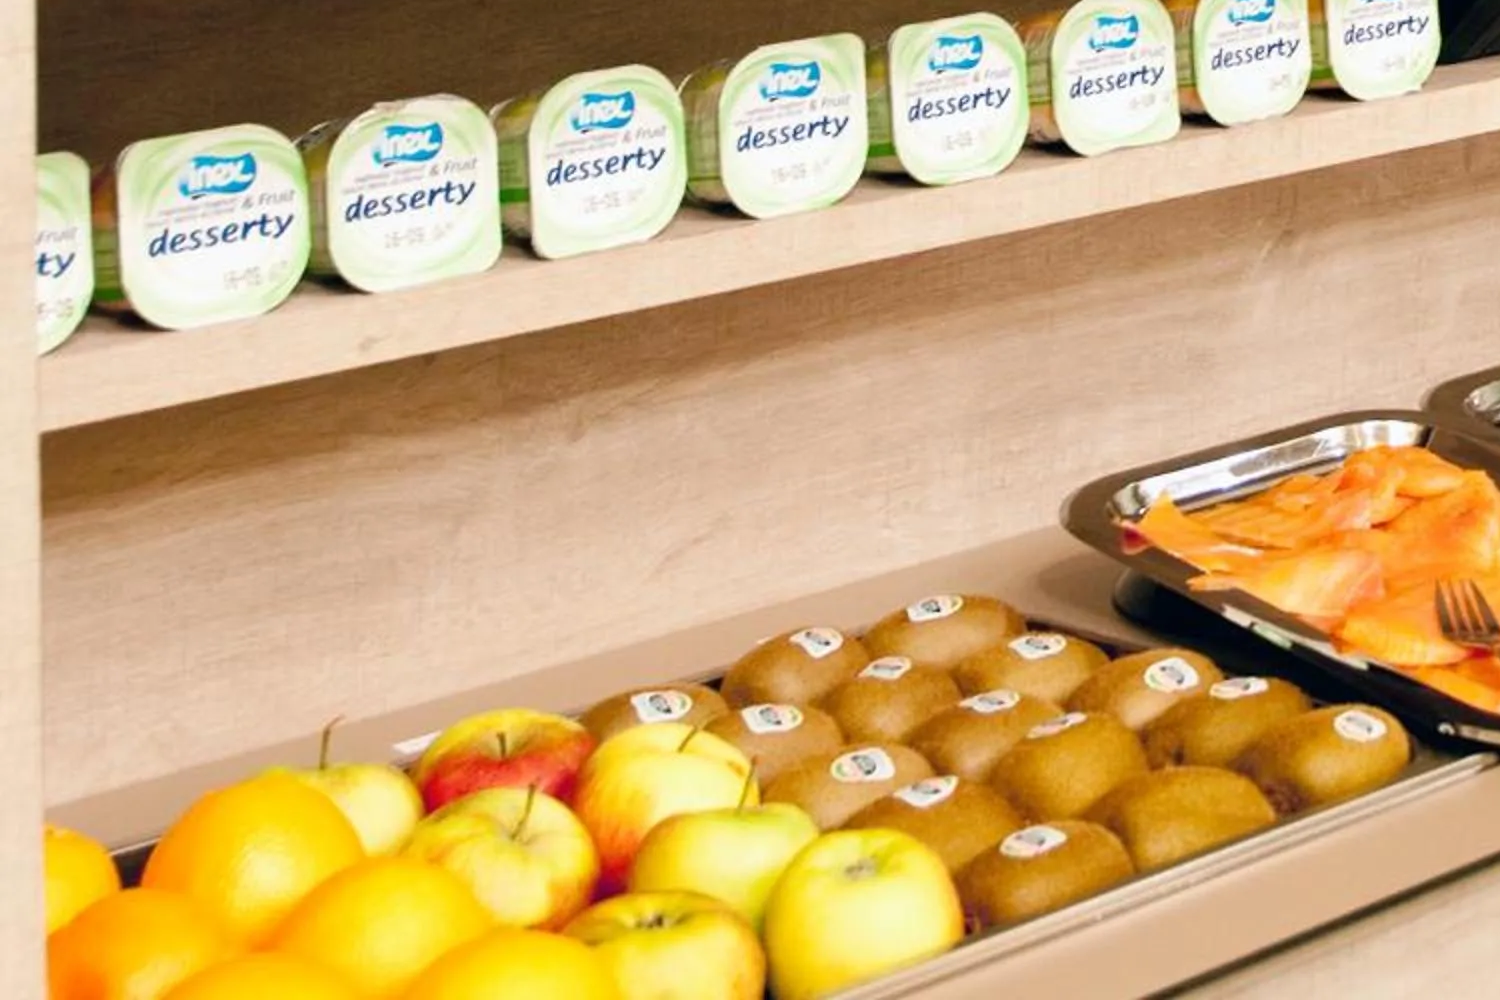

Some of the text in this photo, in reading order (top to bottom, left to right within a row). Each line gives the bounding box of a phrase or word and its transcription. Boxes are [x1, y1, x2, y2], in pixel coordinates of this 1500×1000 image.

[1344, 16, 1430, 45] desserty
[1211, 38, 1300, 70] desserty
[1069, 65, 1164, 99] desserty
[908, 87, 1011, 122] desserty
[737, 115, 849, 152] desserty
[546, 147, 666, 187] desserty
[345, 181, 476, 222] desserty
[149, 213, 294, 257] desserty
